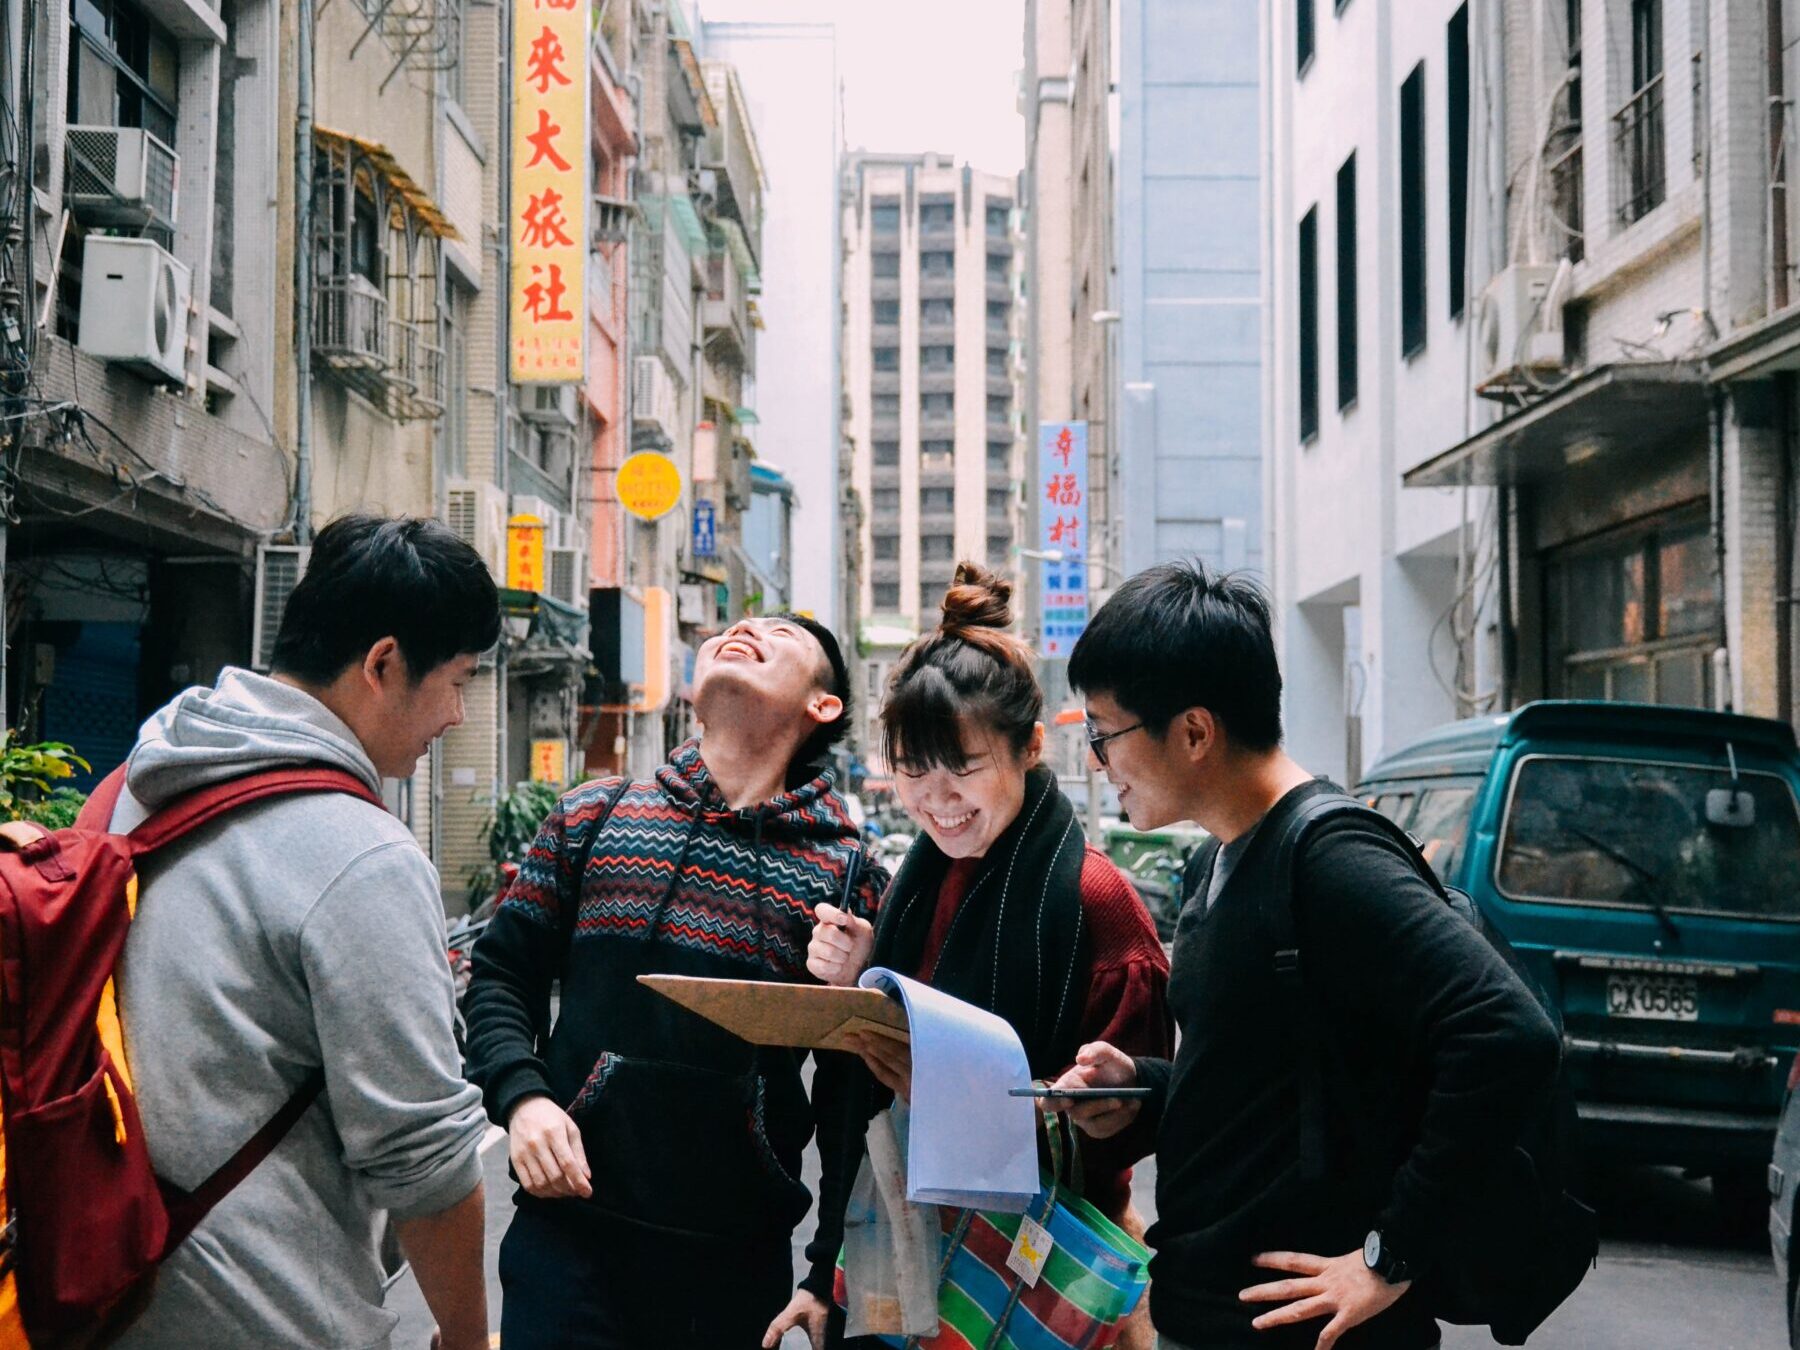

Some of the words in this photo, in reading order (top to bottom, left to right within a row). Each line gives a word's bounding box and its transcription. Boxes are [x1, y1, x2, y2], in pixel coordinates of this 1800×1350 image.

[520, 0, 575, 324] 來大旅社
[1046, 427, 1081, 548] 幸福村
